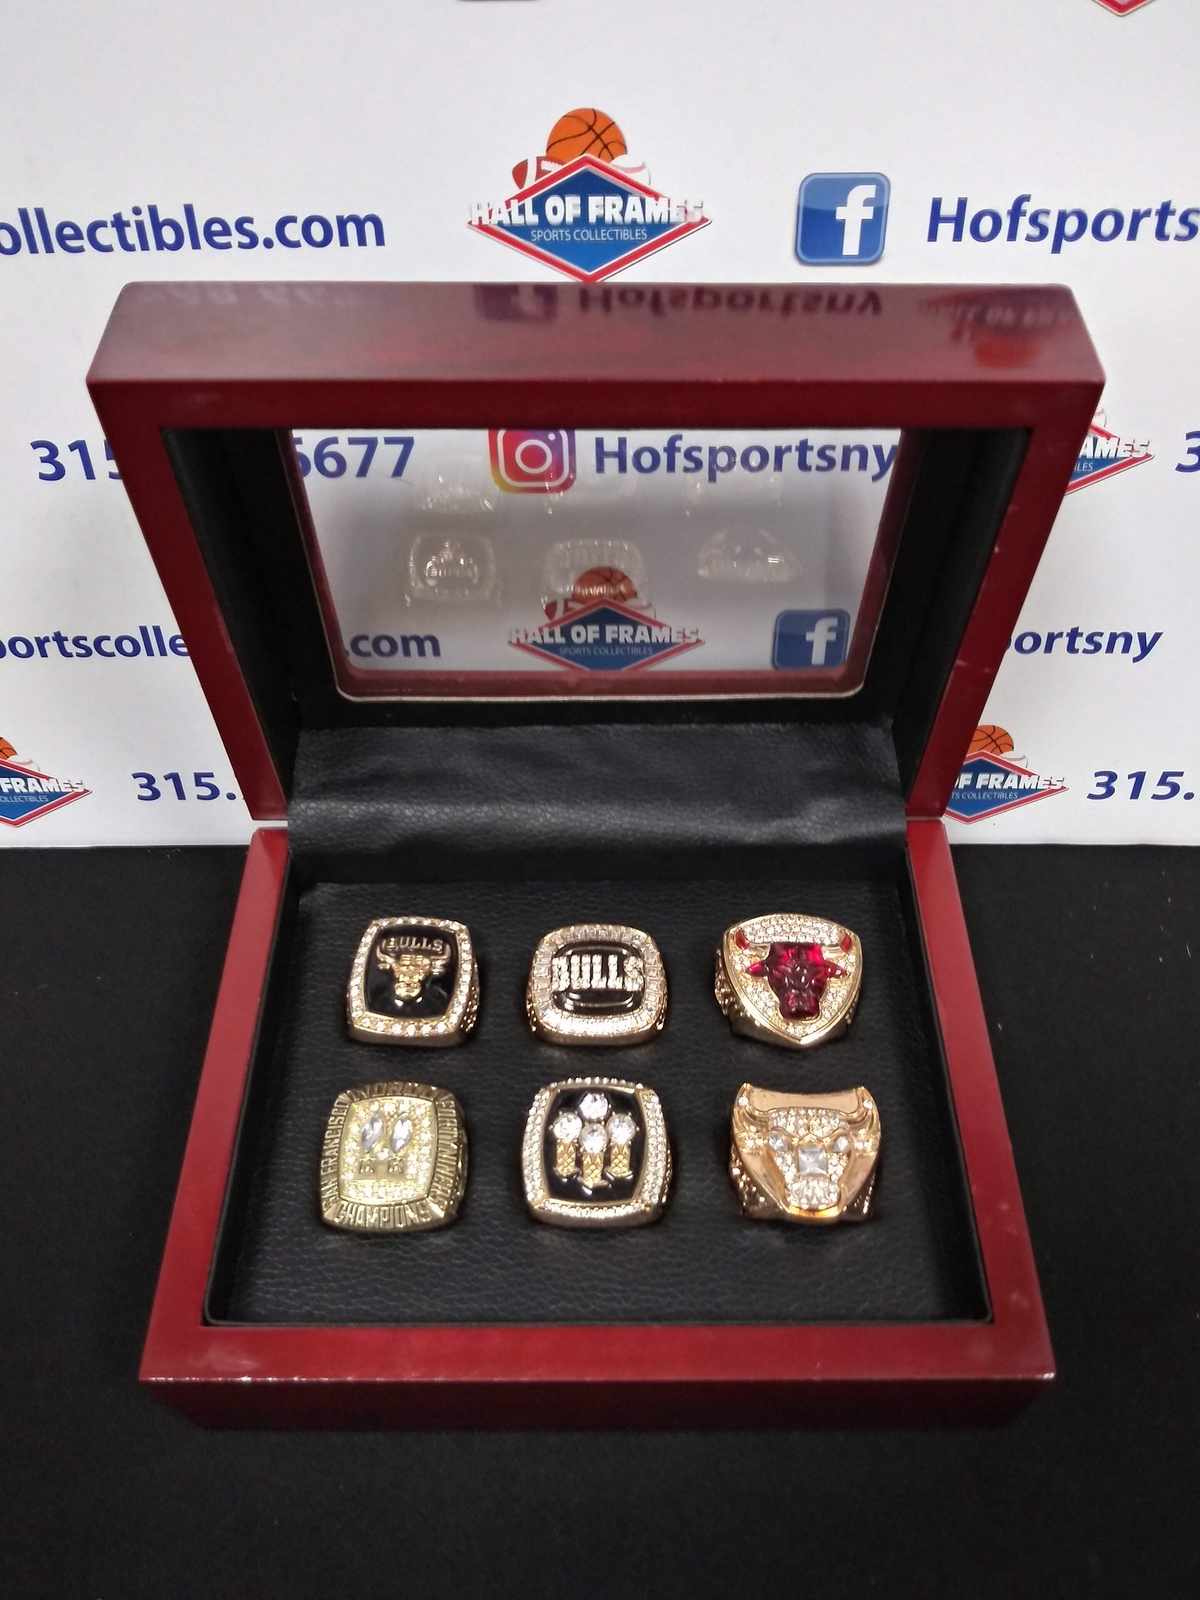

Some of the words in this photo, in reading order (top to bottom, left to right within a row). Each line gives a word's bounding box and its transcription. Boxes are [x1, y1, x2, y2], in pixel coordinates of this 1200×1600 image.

[470, 198, 539, 226] HALL
[545, 195, 581, 226] OF
[588, 195, 704, 224] FRAMES
[531, 227, 572, 242] SPORTS
[573, 227, 648, 241] COLLECTIBLES
[595, 434, 898, 483] Hofsportsny
[510, 627, 566, 644] HALL
[570, 625, 600, 644] OF
[605, 625, 699, 644] FRAMES
[1005, 626, 1164, 664] ortsny
[559, 647, 592, 656] SPORTS
[593, 647, 654, 656] COLLECTIBLES
[0, 778, 84, 793] FRAMES
[976, 773, 1065, 789] FRAMES
[962, 791, 1018, 799] COLLECTIBLES
[552, 953, 645, 992] BULLS
[320, 1098, 350, 1176] FRANCISCO
[334, 1200, 433, 1229] CHAMPIONS
